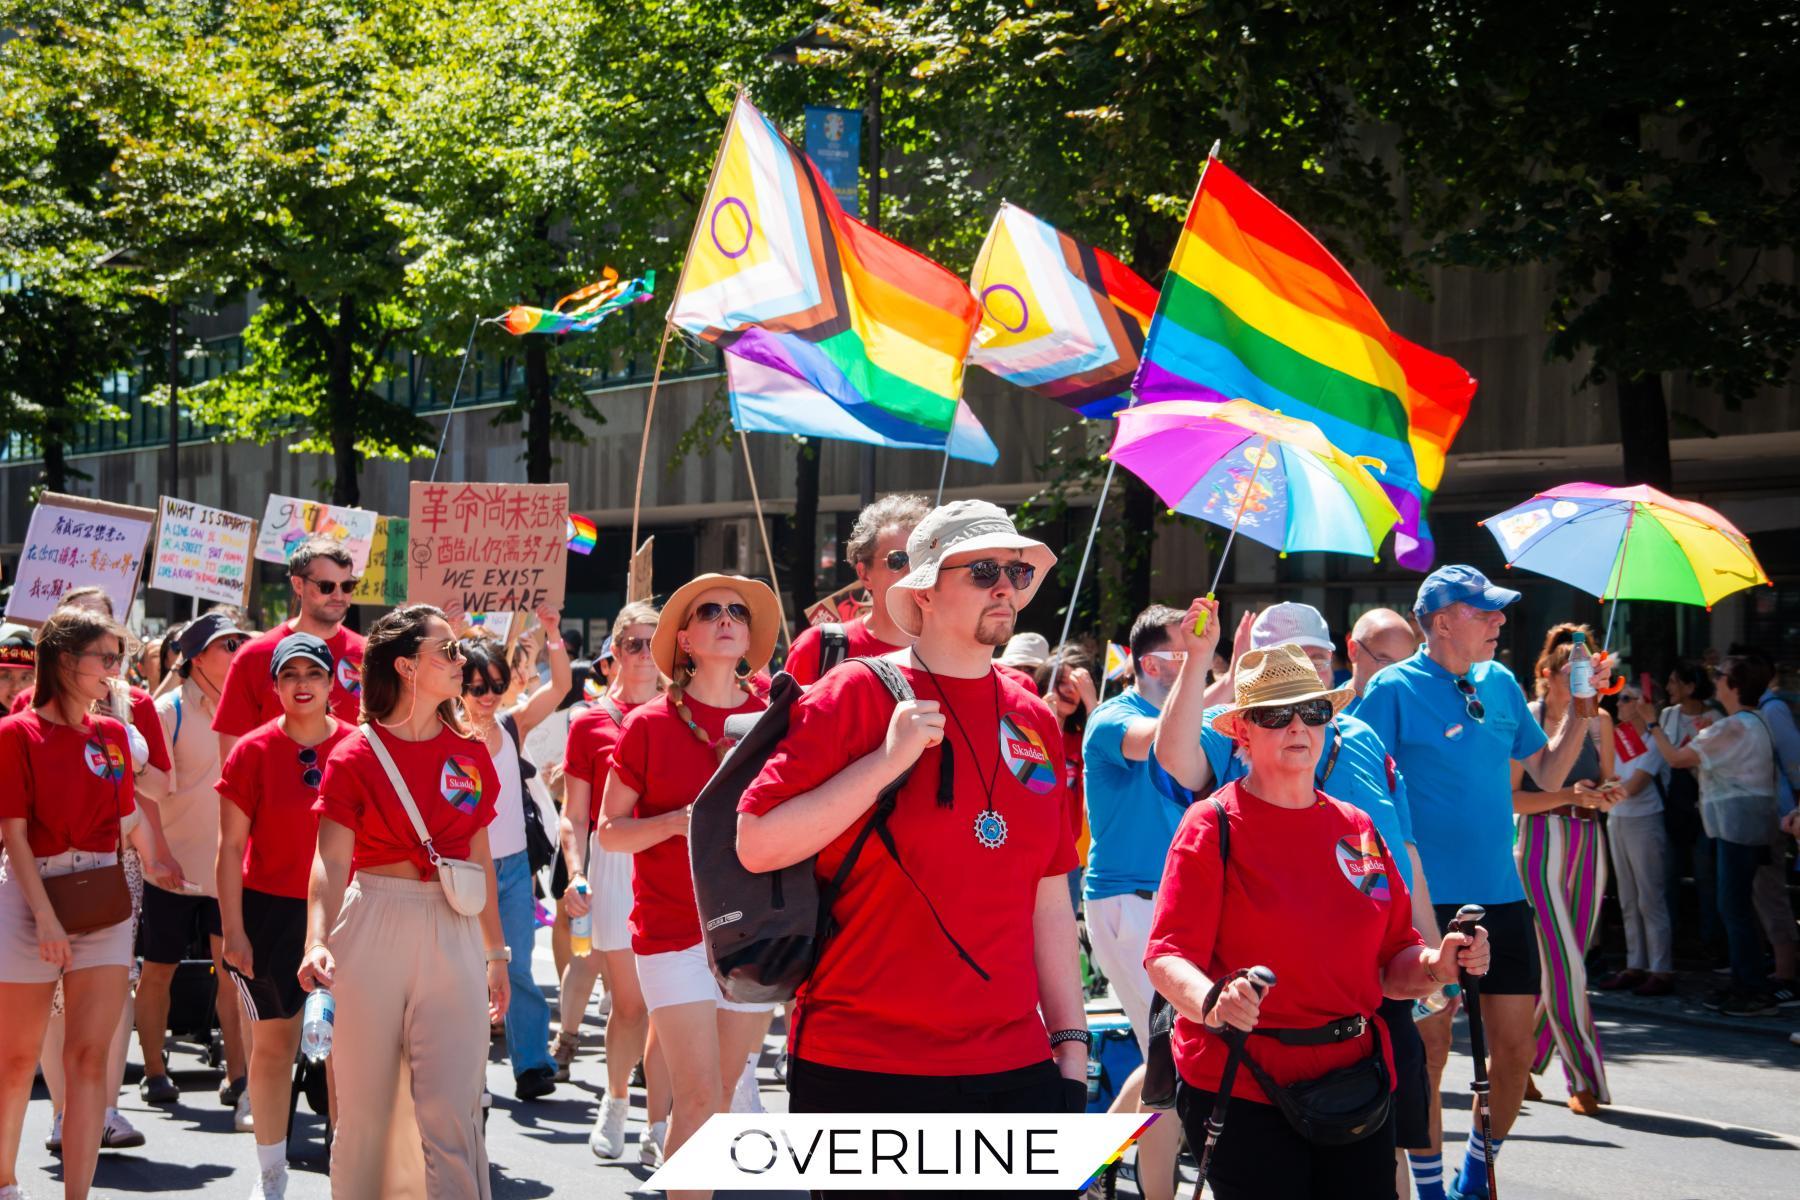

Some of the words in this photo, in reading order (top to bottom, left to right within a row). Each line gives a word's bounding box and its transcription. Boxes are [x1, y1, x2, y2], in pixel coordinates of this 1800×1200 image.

[167, 500, 195, 521] WHAT
[200, 510, 214, 526] IS
[421, 485, 568, 534] 革命尚未结束
[163, 522, 171, 534] A
[190, 528, 205, 540] CAN
[437, 534, 562, 565] 酷儿仍需努力
[442, 567, 476, 589] WE
[482, 567, 545, 587] EXIST
[463, 591, 499, 613] WE
[500, 588, 548, 613] ARE
[1012, 743, 1045, 761] Skadden
